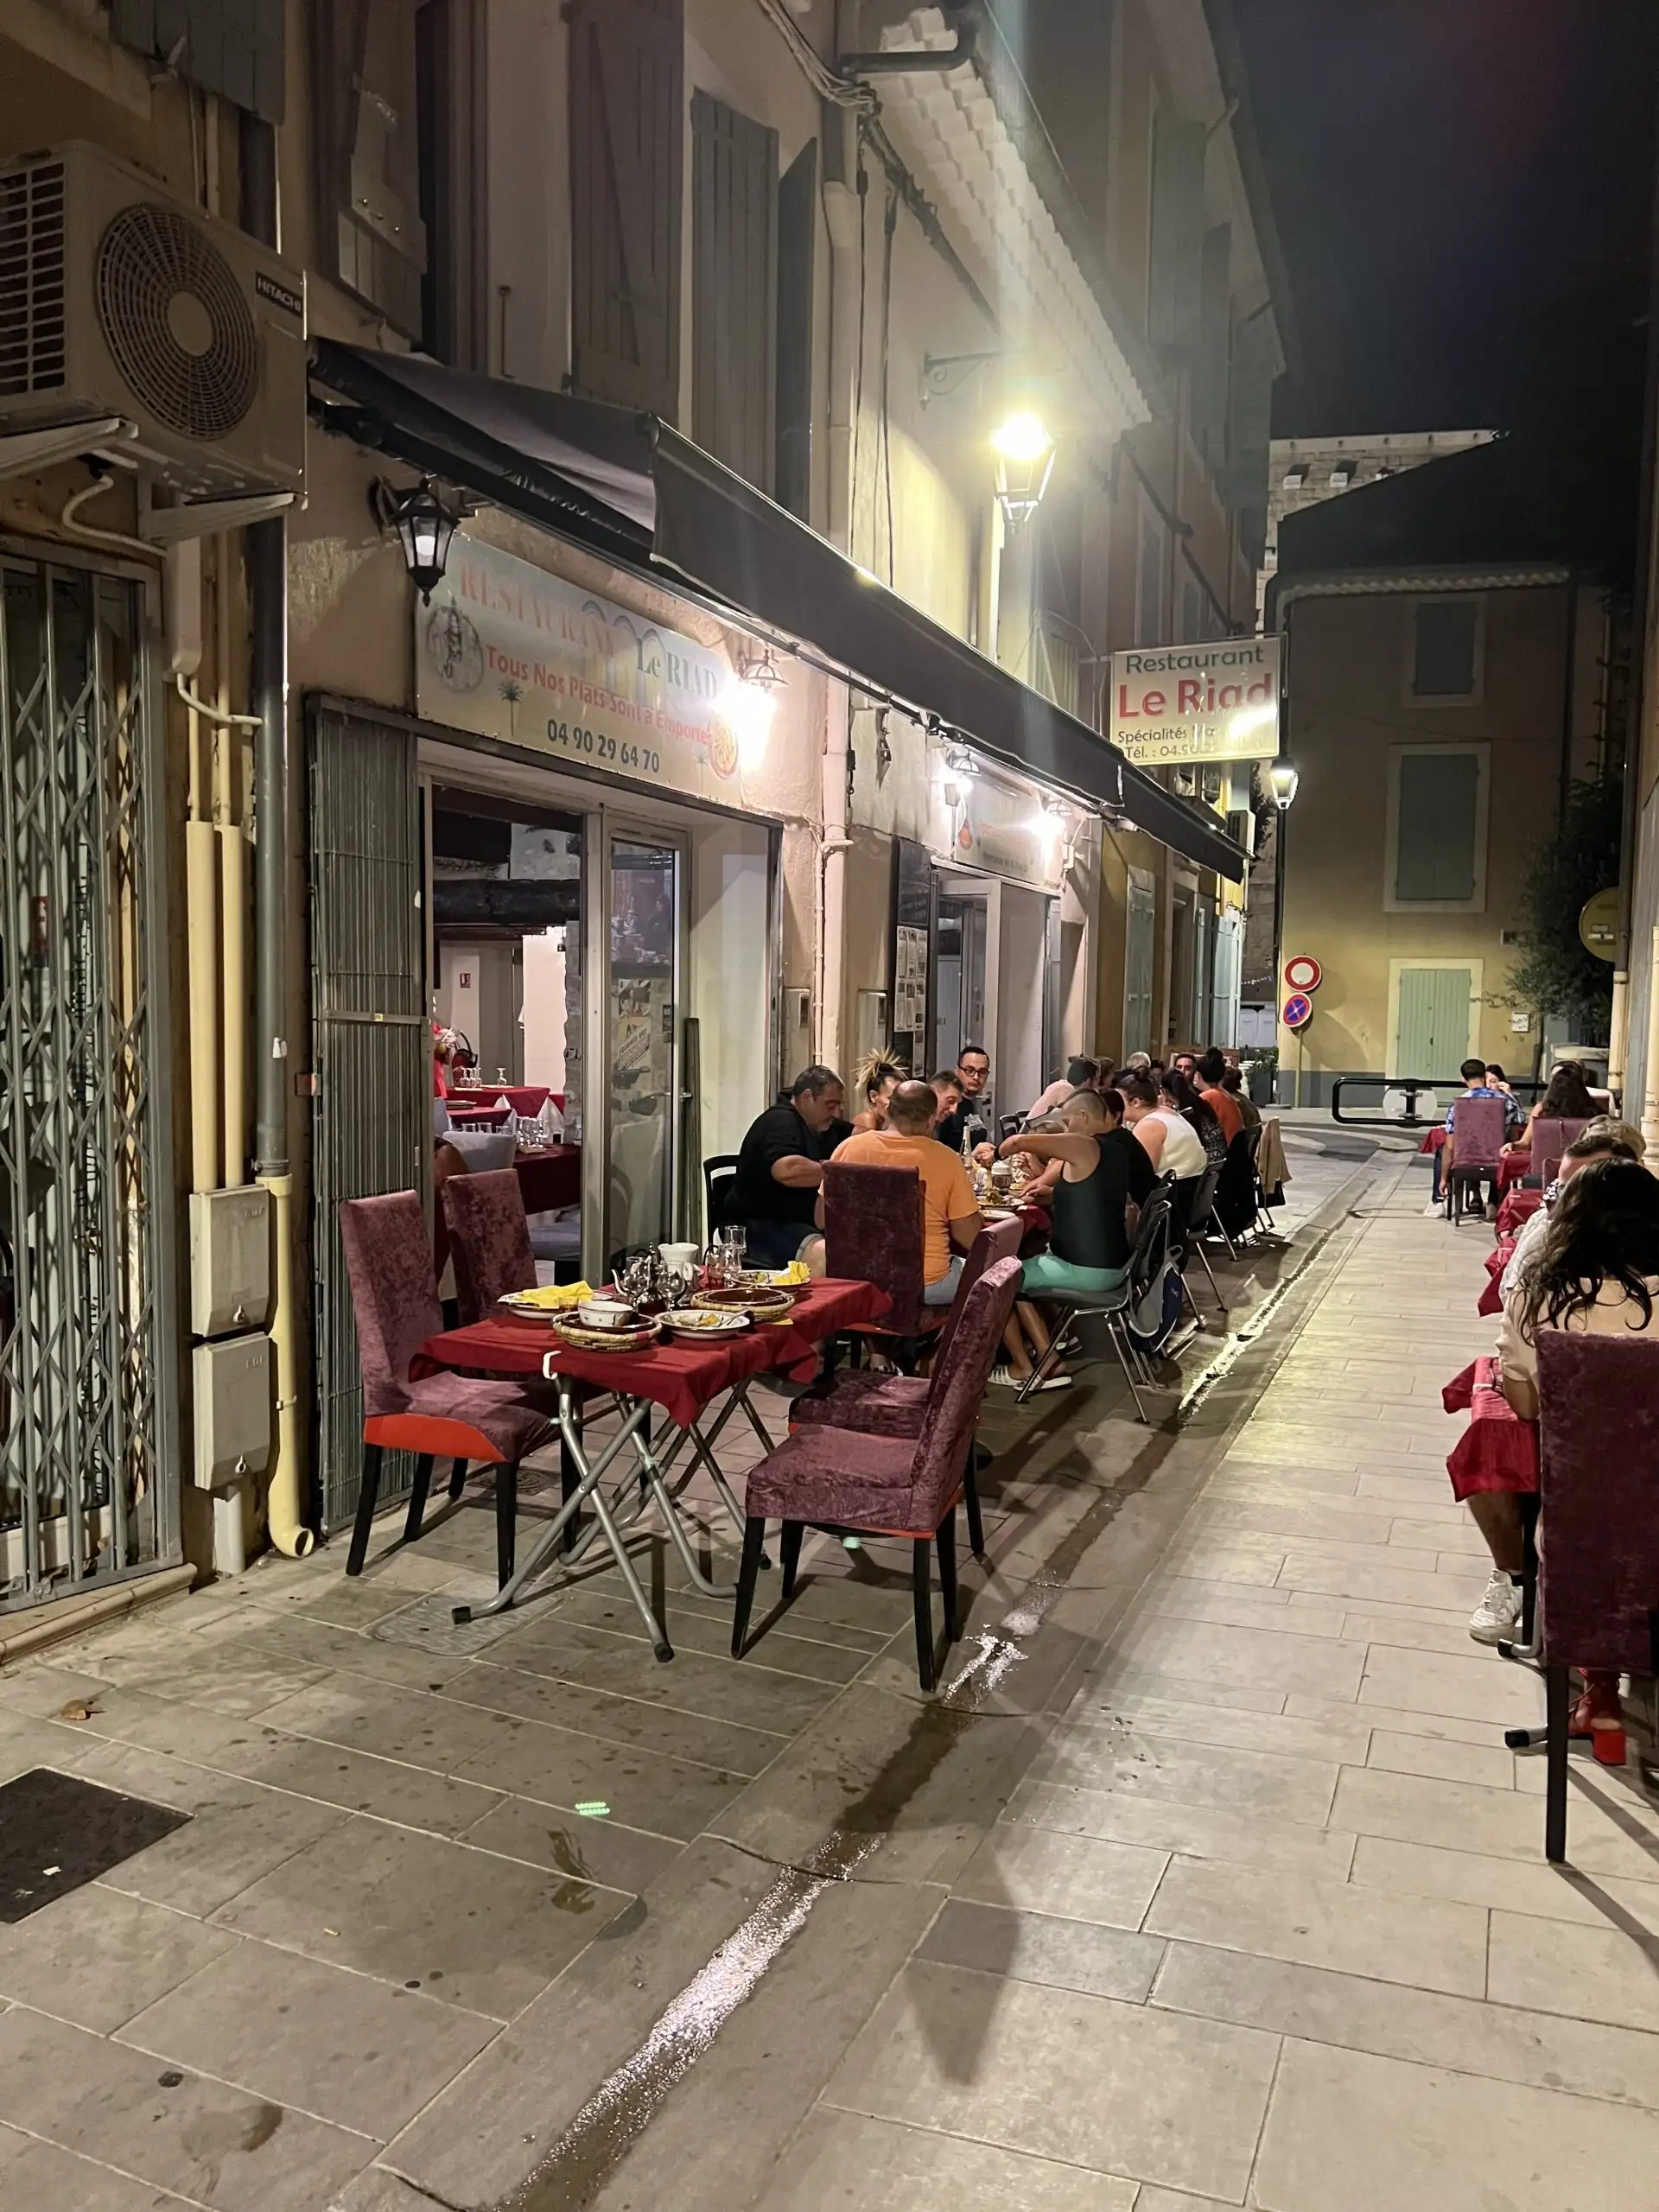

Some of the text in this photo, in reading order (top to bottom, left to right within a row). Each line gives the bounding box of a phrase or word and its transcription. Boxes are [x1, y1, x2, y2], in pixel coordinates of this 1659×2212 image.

[257, 277, 302, 311] HITACHI
[637, 638, 718, 702] Le RIAD
[1126, 647, 1265, 674] Restaurant
[486, 644, 528, 680] Tous
[533, 662, 564, 695] Nos
[569, 675, 605, 709] Plats
[610, 693, 642, 723] Sont
[1119, 672, 1273, 718] Le Riad
[547, 719, 659, 773] 04 90 29 64 70
[1117, 728, 1187, 745] Spécialités
[1125, 746, 1147, 759] Tél.
